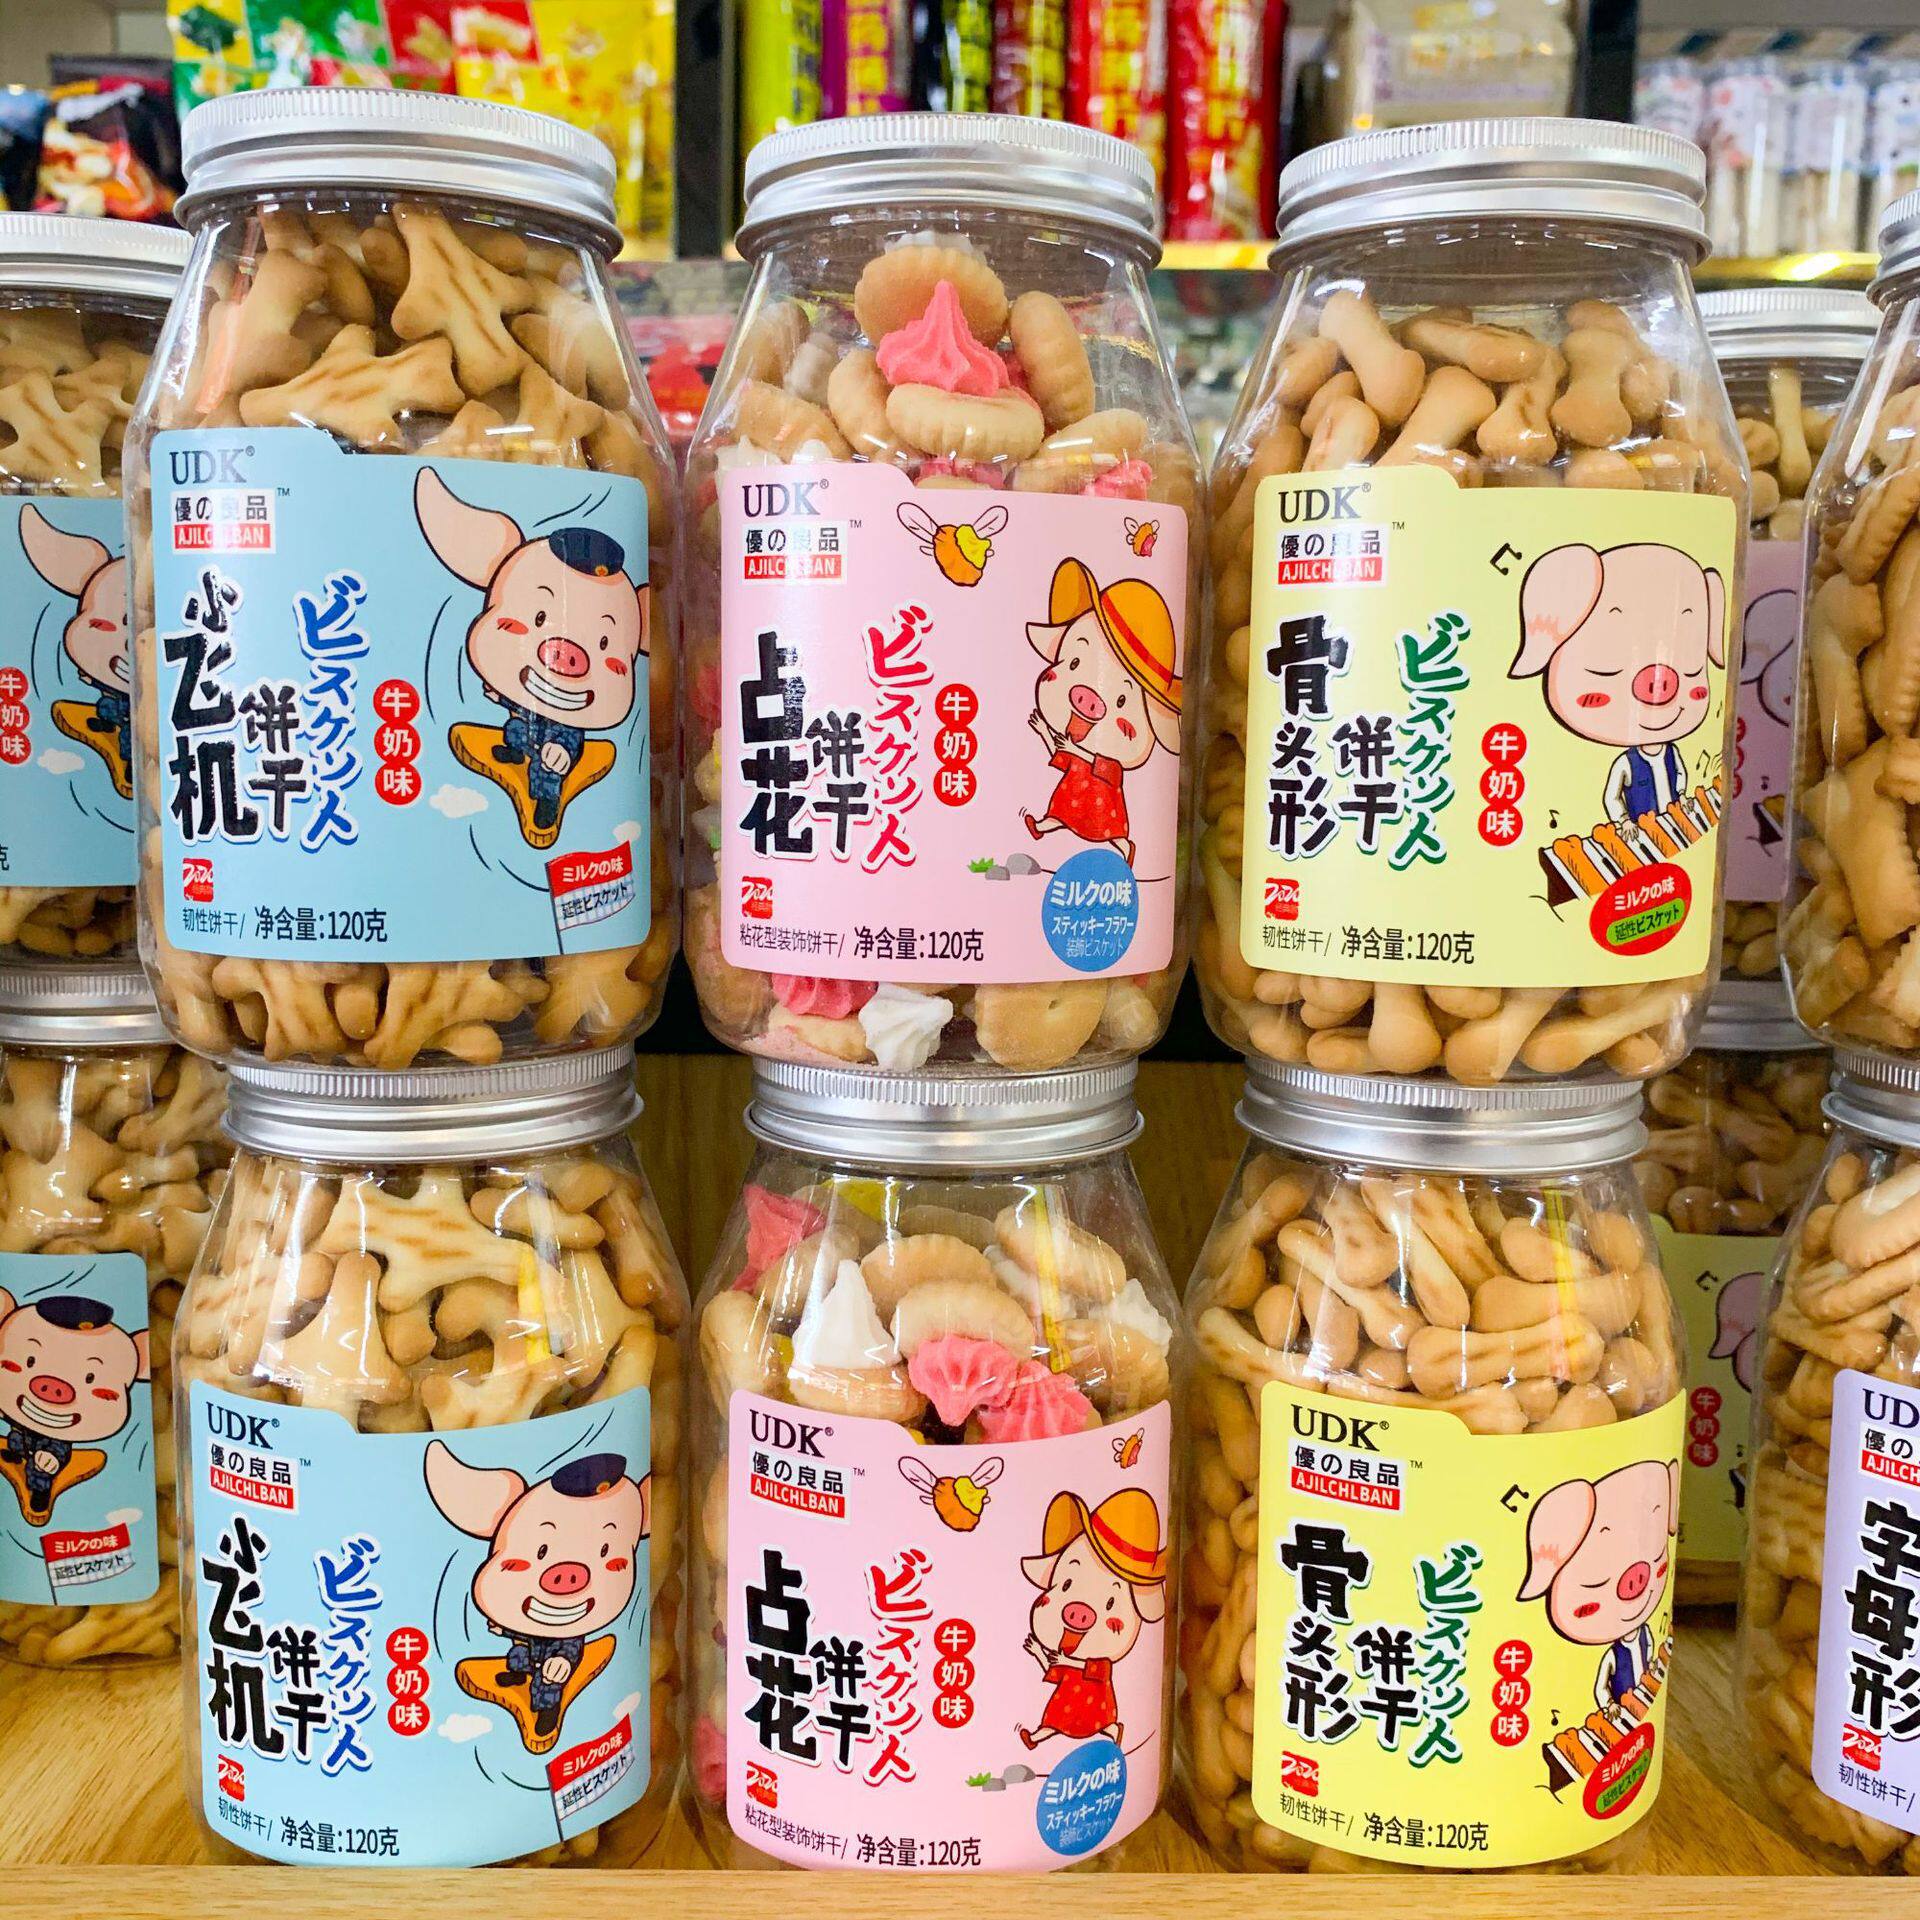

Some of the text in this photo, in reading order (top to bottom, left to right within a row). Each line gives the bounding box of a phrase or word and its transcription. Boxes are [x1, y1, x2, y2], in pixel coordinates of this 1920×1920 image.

[177, 527, 265, 546] AJILCLBAN
[1282, 562, 1376, 582] AJILCHBAN
[164, 571, 258, 840] 小飞机
[381, 688, 414, 797] 牛奶味
[740, 631, 813, 854] 占花
[941, 692, 971, 799] 牛奶味
[1267, 615, 1348, 855] 骨头形
[238, 685, 307, 832] 饼干
[805, 711, 869, 852] 饼干
[1332, 715, 1398, 846] 饼干
[1486, 731, 1519, 838] 牛奶味
[562, 856, 624, 882] ミルクの味
[1050, 879, 1132, 906] ミルクの味
[1615, 876, 1675, 910] ミルクの味
[255, 906, 388, 943] 净含量:120克
[854, 926, 984, 962] 净含量:120克
[1341, 925, 1475, 964] 净含量:120克
[211, 1443, 291, 1485] 優の良品
[753, 1451, 843, 1494] 優の良品
[1295, 1445, 1400, 1486] 優の良品
[55, 1535, 118, 1553] ミルクの味
[202, 1518, 284, 1753] 小飞机
[745, 1549, 816, 1761] 占花
[940, 1626, 968, 1721] 牛奶味
[1281, 1524, 1369, 1737] 骨头形
[267, 1626, 326, 1755] 饼干
[394, 1634, 423, 1728] 牛奶味
[809, 1636, 871, 1766] 饼干
[1354, 1626, 1418, 1743] 饼干
[1497, 1647, 1525, 1739] 牛奶味
[563, 1732, 623, 1776] ミルクの味
[1045, 1758, 1120, 1804] ミルクの味
[281, 1815, 400, 1857] 净含量:120克
[857, 1833, 981, 1867] 净含量:120克
[1364, 1812, 1488, 1851] 净含量:120克
